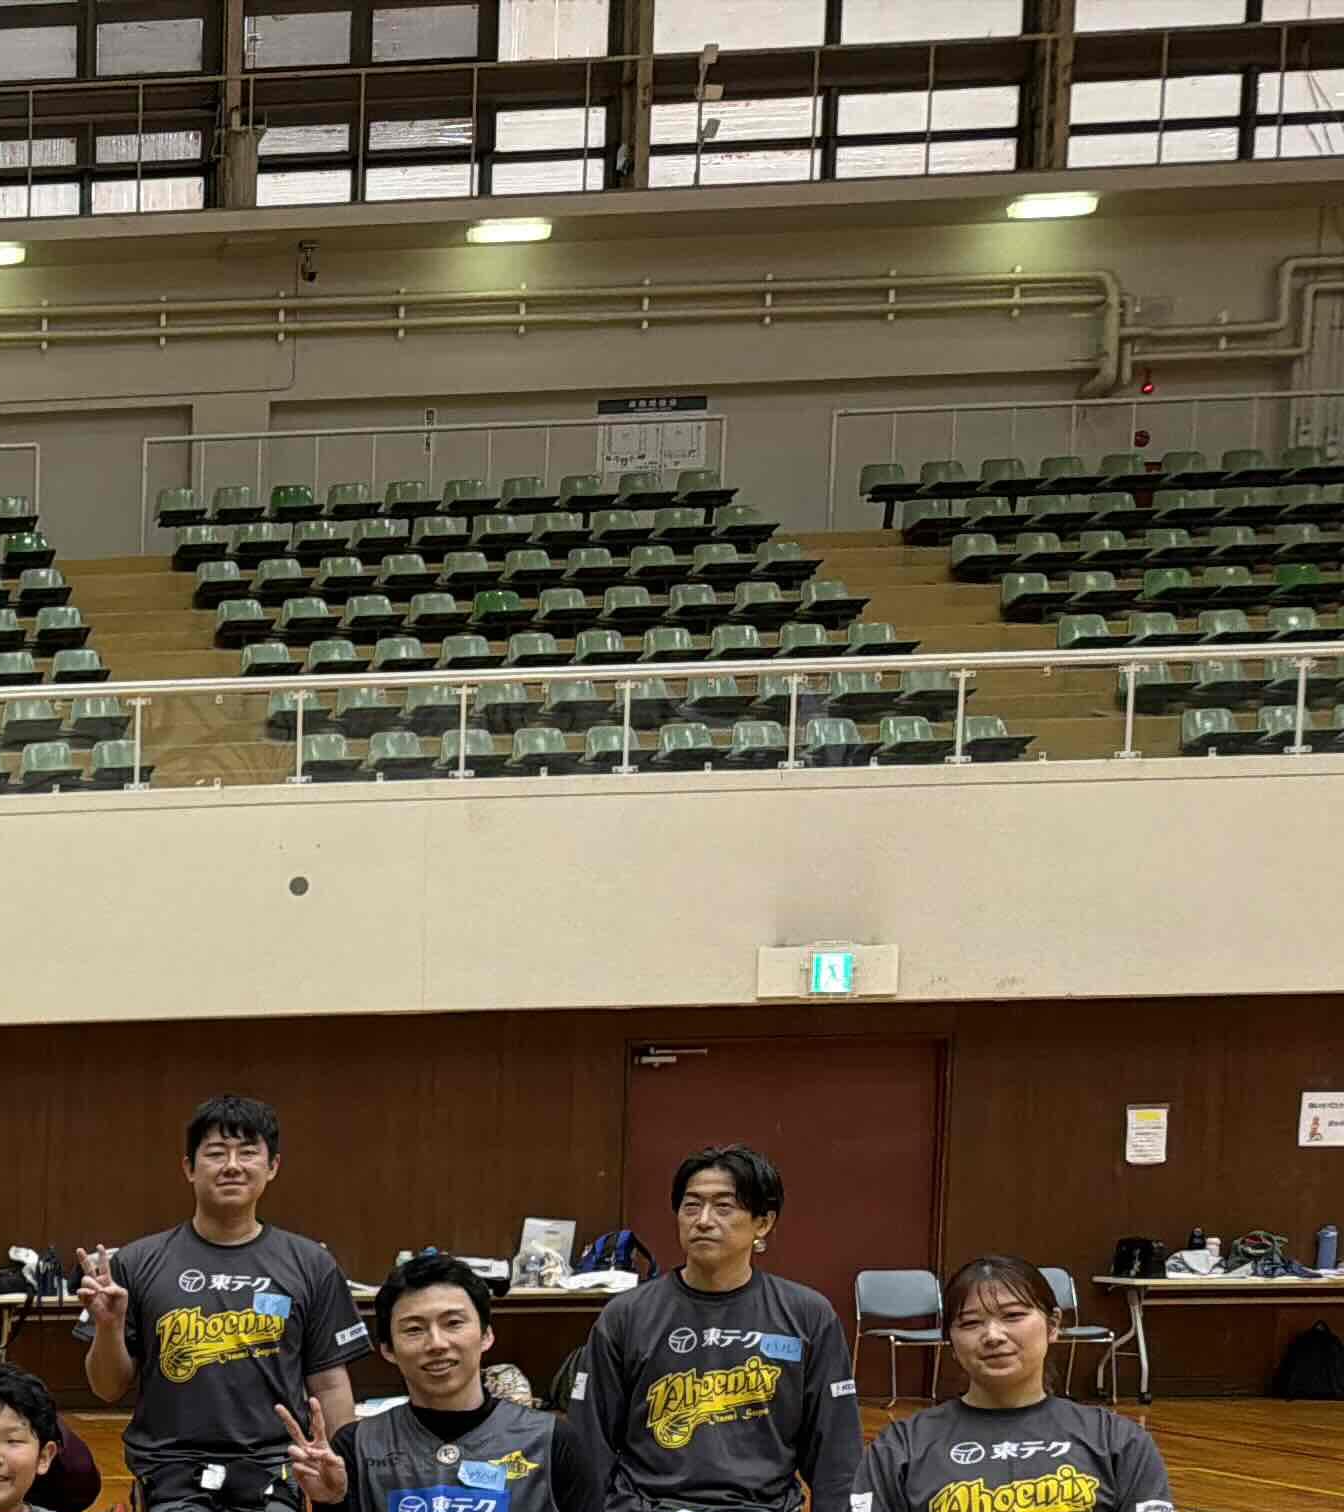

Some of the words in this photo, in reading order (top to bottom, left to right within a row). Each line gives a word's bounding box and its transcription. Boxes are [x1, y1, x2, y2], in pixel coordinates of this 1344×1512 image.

[209, 1273, 272, 1292] 東テク
[701, 1327, 762, 1348] 東テク
[648, 1356, 782, 1428] Phoenix
[991, 1440, 1072, 1460] 東テク
